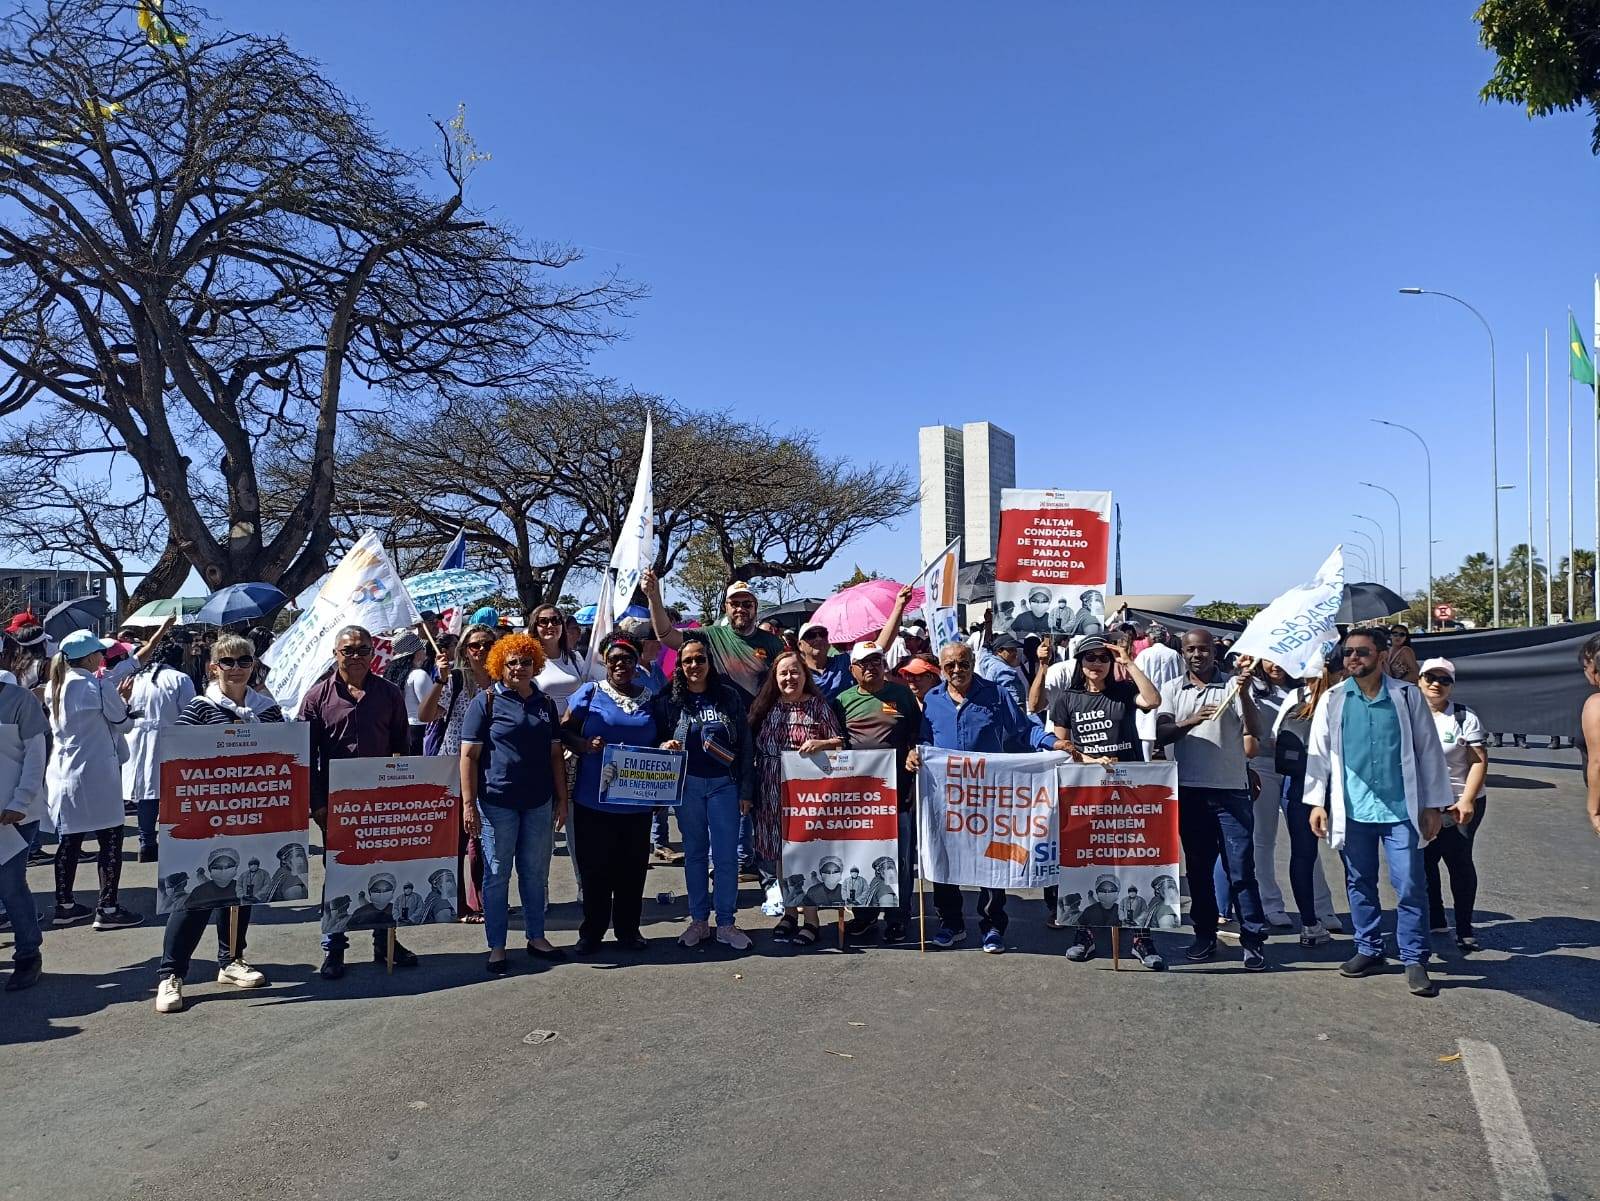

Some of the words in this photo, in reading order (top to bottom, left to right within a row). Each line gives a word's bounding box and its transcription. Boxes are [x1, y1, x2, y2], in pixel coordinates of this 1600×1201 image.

[1034, 518, 1074, 526] FALTAM
[1024, 527, 1082, 538] CONDIÇÕES
[1017, 538, 1031, 546] DE
[1032, 538, 1088, 548] TRABALHO
[1033, 549, 1060, 557] PARA
[1017, 559, 1068, 568] SERVIDOR
[1070, 561, 1085, 569] DA
[1032, 568, 1069, 578] SAÚDE!
[1075, 710, 1104, 722] Lute
[1077, 720, 1113, 733] como
[1079, 731, 1108, 743] uma
[624, 758, 637, 769] EM
[640, 760, 672, 771] DEFESA
[946, 755, 986, 779] EM
[180, 764, 276, 780] VALORIZAR
[279, 764, 291, 775] A
[620, 770, 629, 778] DO
[630, 770, 645, 779] PISO
[646, 772, 676, 780] NACIONAL
[176, 780, 292, 797] ENFERMAGEM
[619, 779, 628, 787] DA
[796, 792, 860, 803] VALORIZE
[863, 792, 881, 801] OS
[945, 783, 1051, 809] DEFESA
[1111, 790, 1120, 800] A
[180, 799, 192, 813] É
[195, 796, 289, 812] VALORIZAR
[333, 802, 361, 814] NÃO
[363, 801, 372, 812] À
[374, 797, 454, 812] EXPLORAÇÃO
[1070, 804, 1162, 816] ENFERMAGEM
[783, 805, 896, 817] TRABALHADORES
[209, 815, 223, 827] O
[226, 813, 263, 826] SUS!
[340, 816, 358, 826] DA
[360, 811, 447, 825] ENFERMAGEM!
[805, 820, 824, 830] DA
[827, 817, 874, 829] SAÚDE!
[946, 811, 988, 835] DO
[994, 814, 1048, 838] SUS
[1090, 816, 1145, 829] TAMBÉM
[354, 825, 422, 838] QUEREMOS
[424, 824, 433, 832] O
[356, 838, 399, 850] NOSSO
[400, 836, 431, 846] PISO!
[1090, 833, 1145, 844] PRECISA
[1076, 849, 1093, 859] DE
[1095, 848, 1160, 858] CUIDADO!
